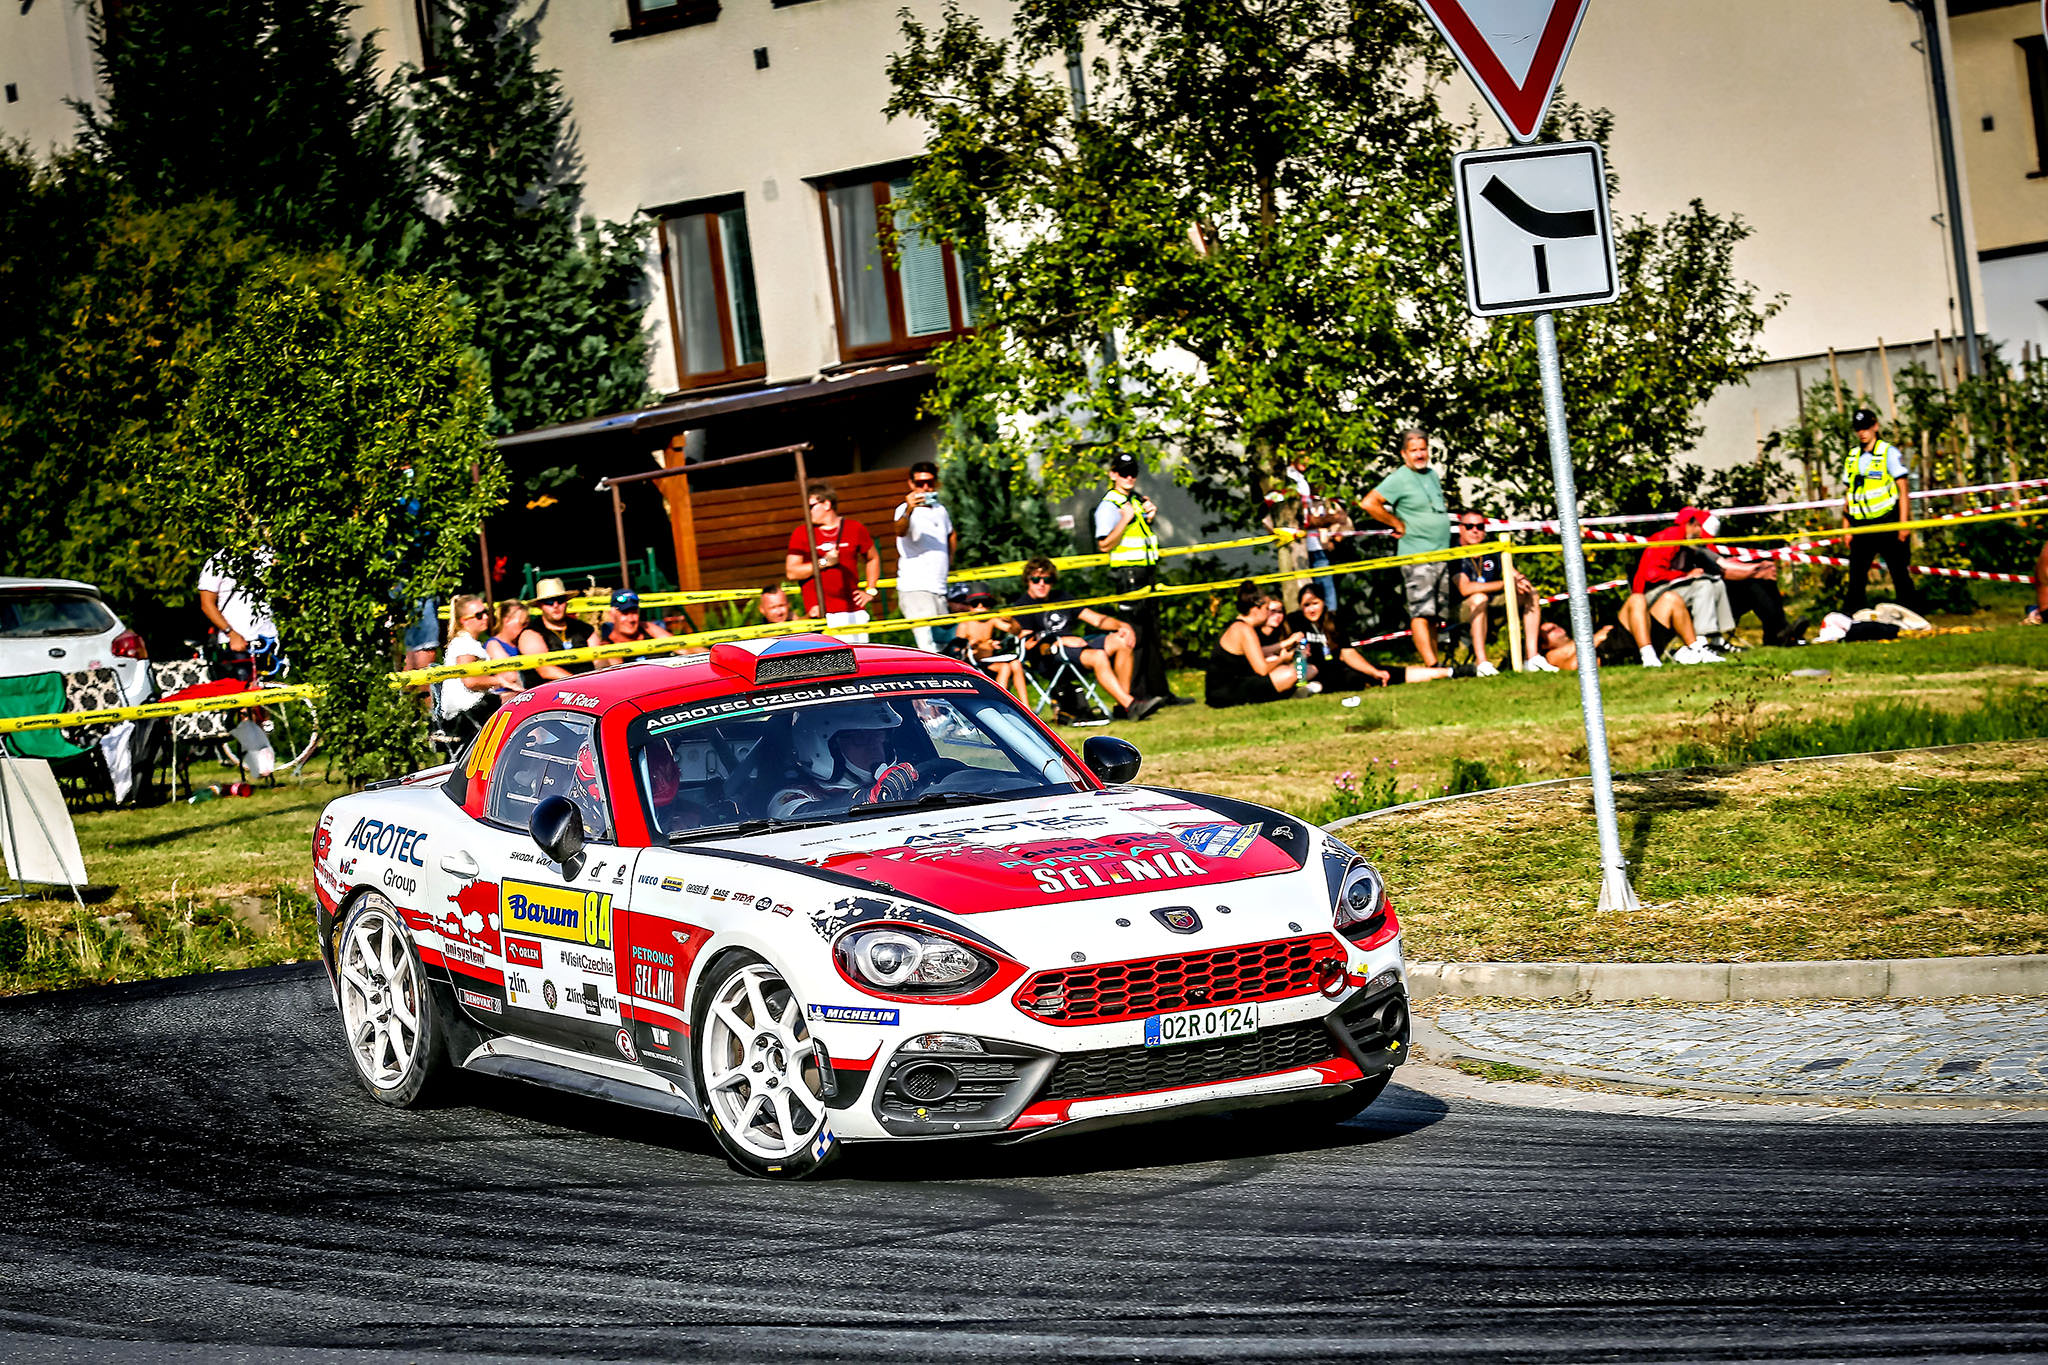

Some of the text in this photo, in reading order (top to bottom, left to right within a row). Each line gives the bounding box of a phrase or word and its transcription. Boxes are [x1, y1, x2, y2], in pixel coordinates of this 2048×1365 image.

[562, 691, 600, 709] M.Rada
[645, 679, 974, 730] AGROTEC CZECH ABARTH TEAM
[903, 814, 1106, 845] AGROTEC
[1041, 819, 1110, 832] Group
[344, 816, 428, 868] AGROTEC
[383, 867, 416, 896] Group
[638, 874, 659, 886] IVECO
[1031, 850, 1209, 895] SELENIA
[713, 888, 730, 898] CASE
[731, 892, 756, 904] STEYR
[508, 894, 579, 928] Barum
[585, 891, 612, 948] 84
[518, 947, 539, 960] ORLEN
[560, 950, 614, 974] #VisitCzechia
[632, 946, 674, 967] PETRONAS
[598, 994, 618, 1014] kraj
[826, 1009, 896, 1022] MICHELIN
[1146, 1036, 1160, 1046] CZ
